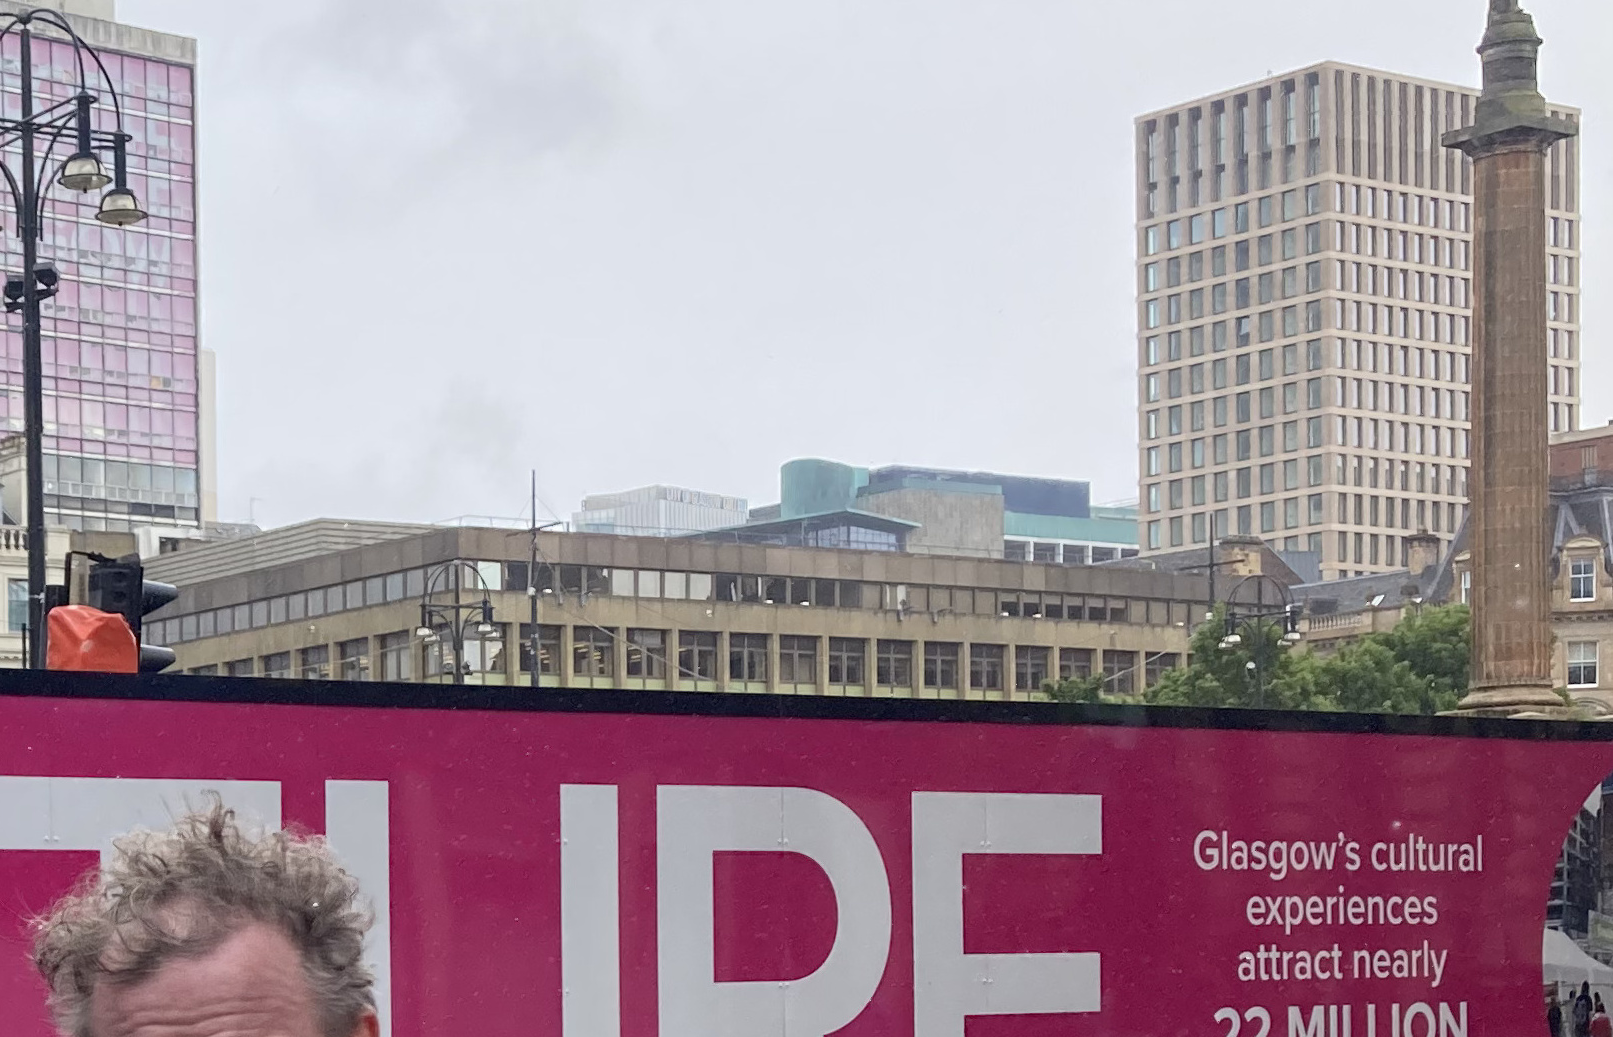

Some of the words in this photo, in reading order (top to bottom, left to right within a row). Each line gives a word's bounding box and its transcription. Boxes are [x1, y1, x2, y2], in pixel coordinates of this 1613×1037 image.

[1193, 830, 1361, 881] Glasgow’s
[1371, 833, 1483, 872] cultural
[1246, 886, 1438, 935] experiences
[1237, 943, 1343, 981] attract
[1353, 940, 1448, 988] nearly
